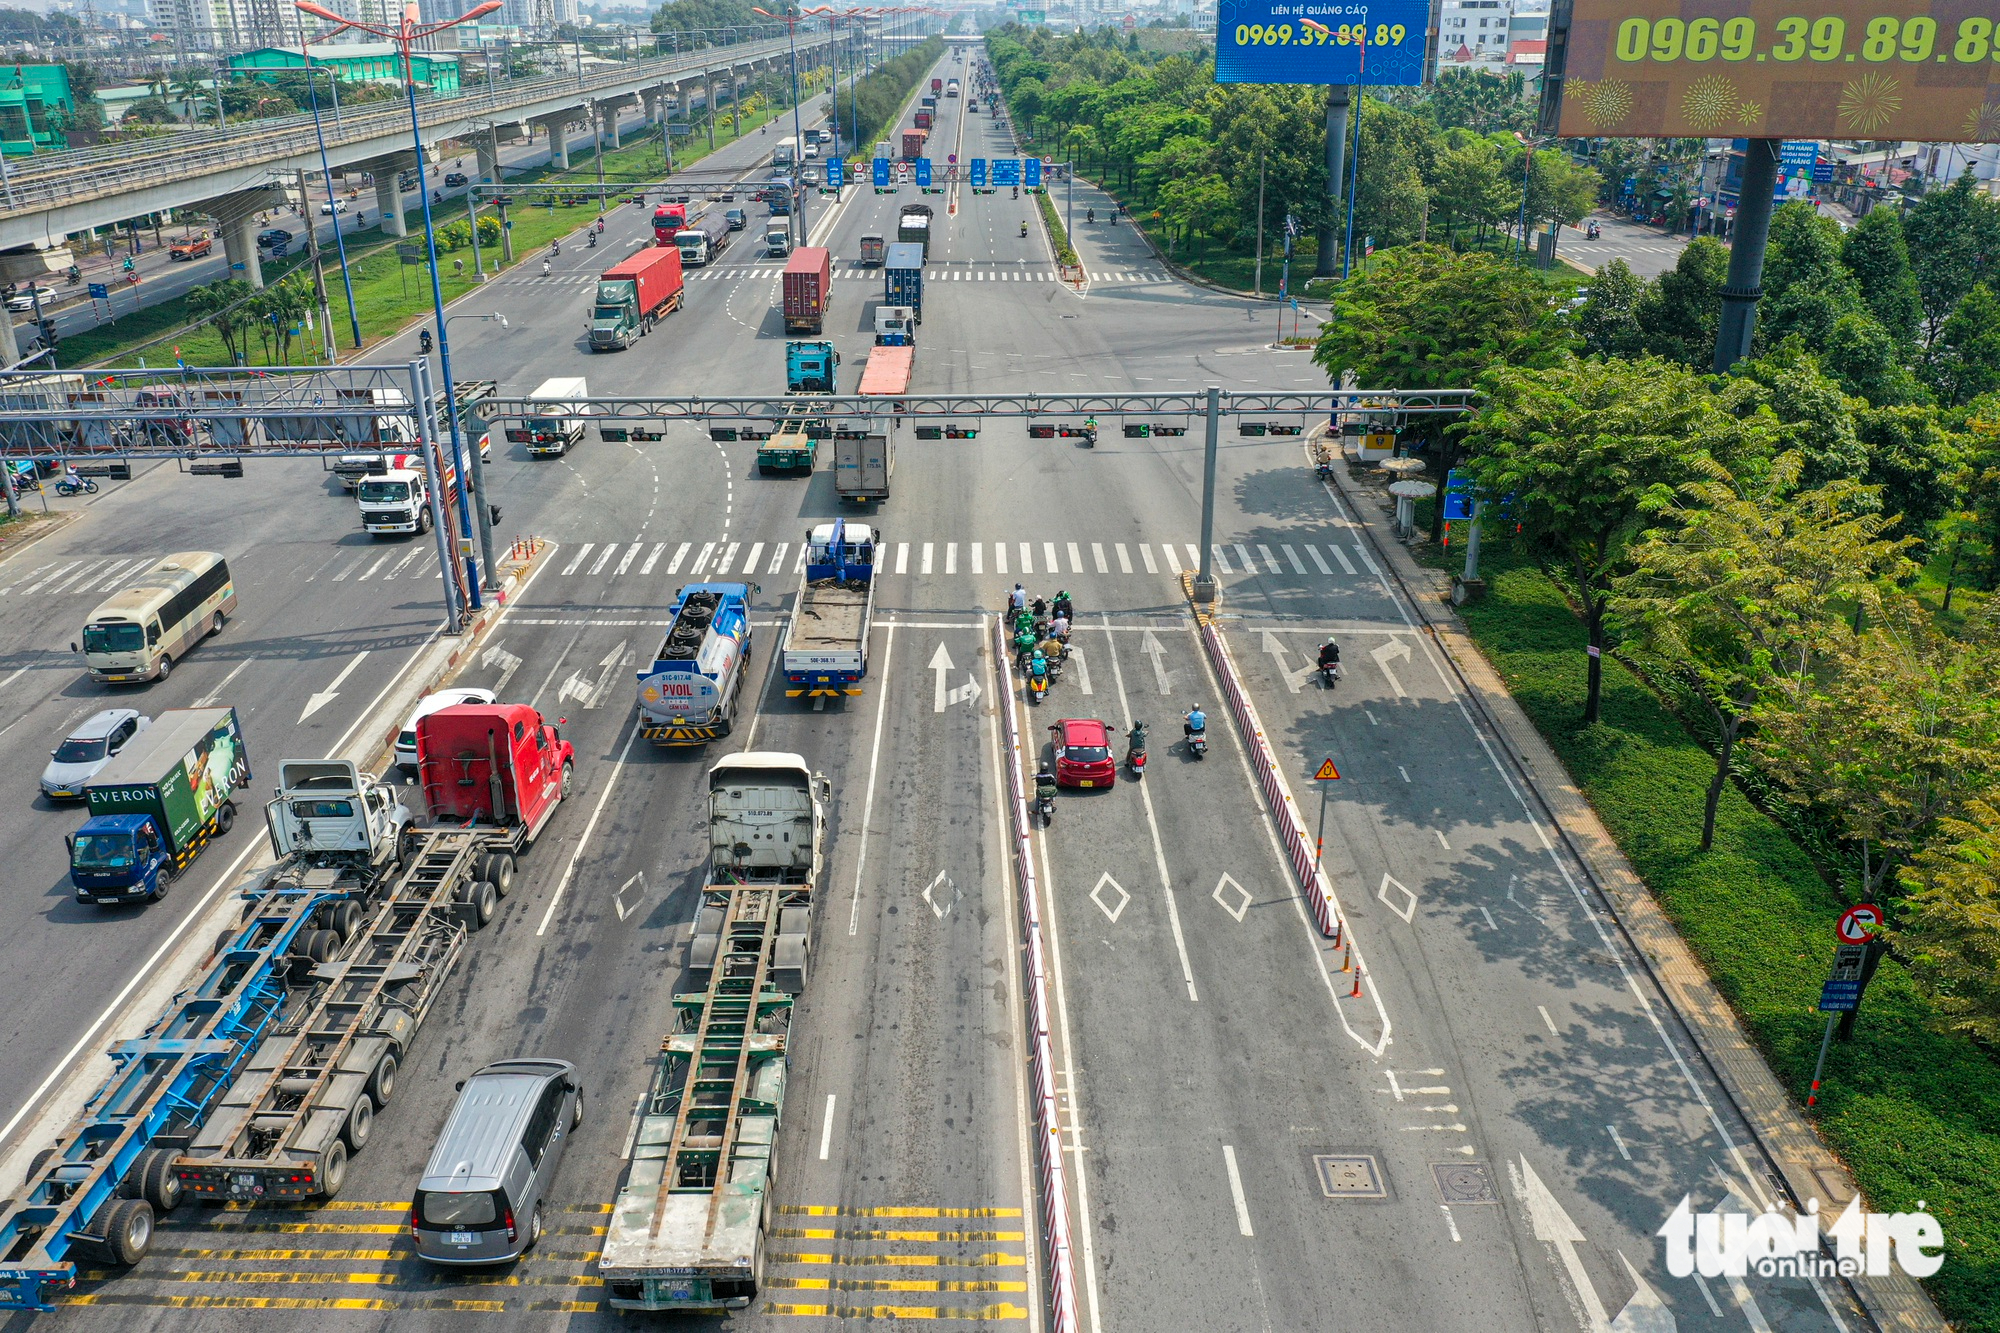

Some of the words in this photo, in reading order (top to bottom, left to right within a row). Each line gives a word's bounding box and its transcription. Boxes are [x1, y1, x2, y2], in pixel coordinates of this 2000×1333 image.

[1271, 5, 1290, 15] LIÊN
[1292, 4, 1304, 17] HỆ
[1306, 4, 1343, 15] QUẢNG
[1345, 4, 1368, 15] CÁO
[1235, 24, 1406, 46] 0969.39.89.89
[1615, 16, 2000, 63] 0969.39.89.8
[662, 684, 693, 697] PVOIL
[200, 757, 246, 816] EVERON
[91, 790, 156, 803] EVERON
